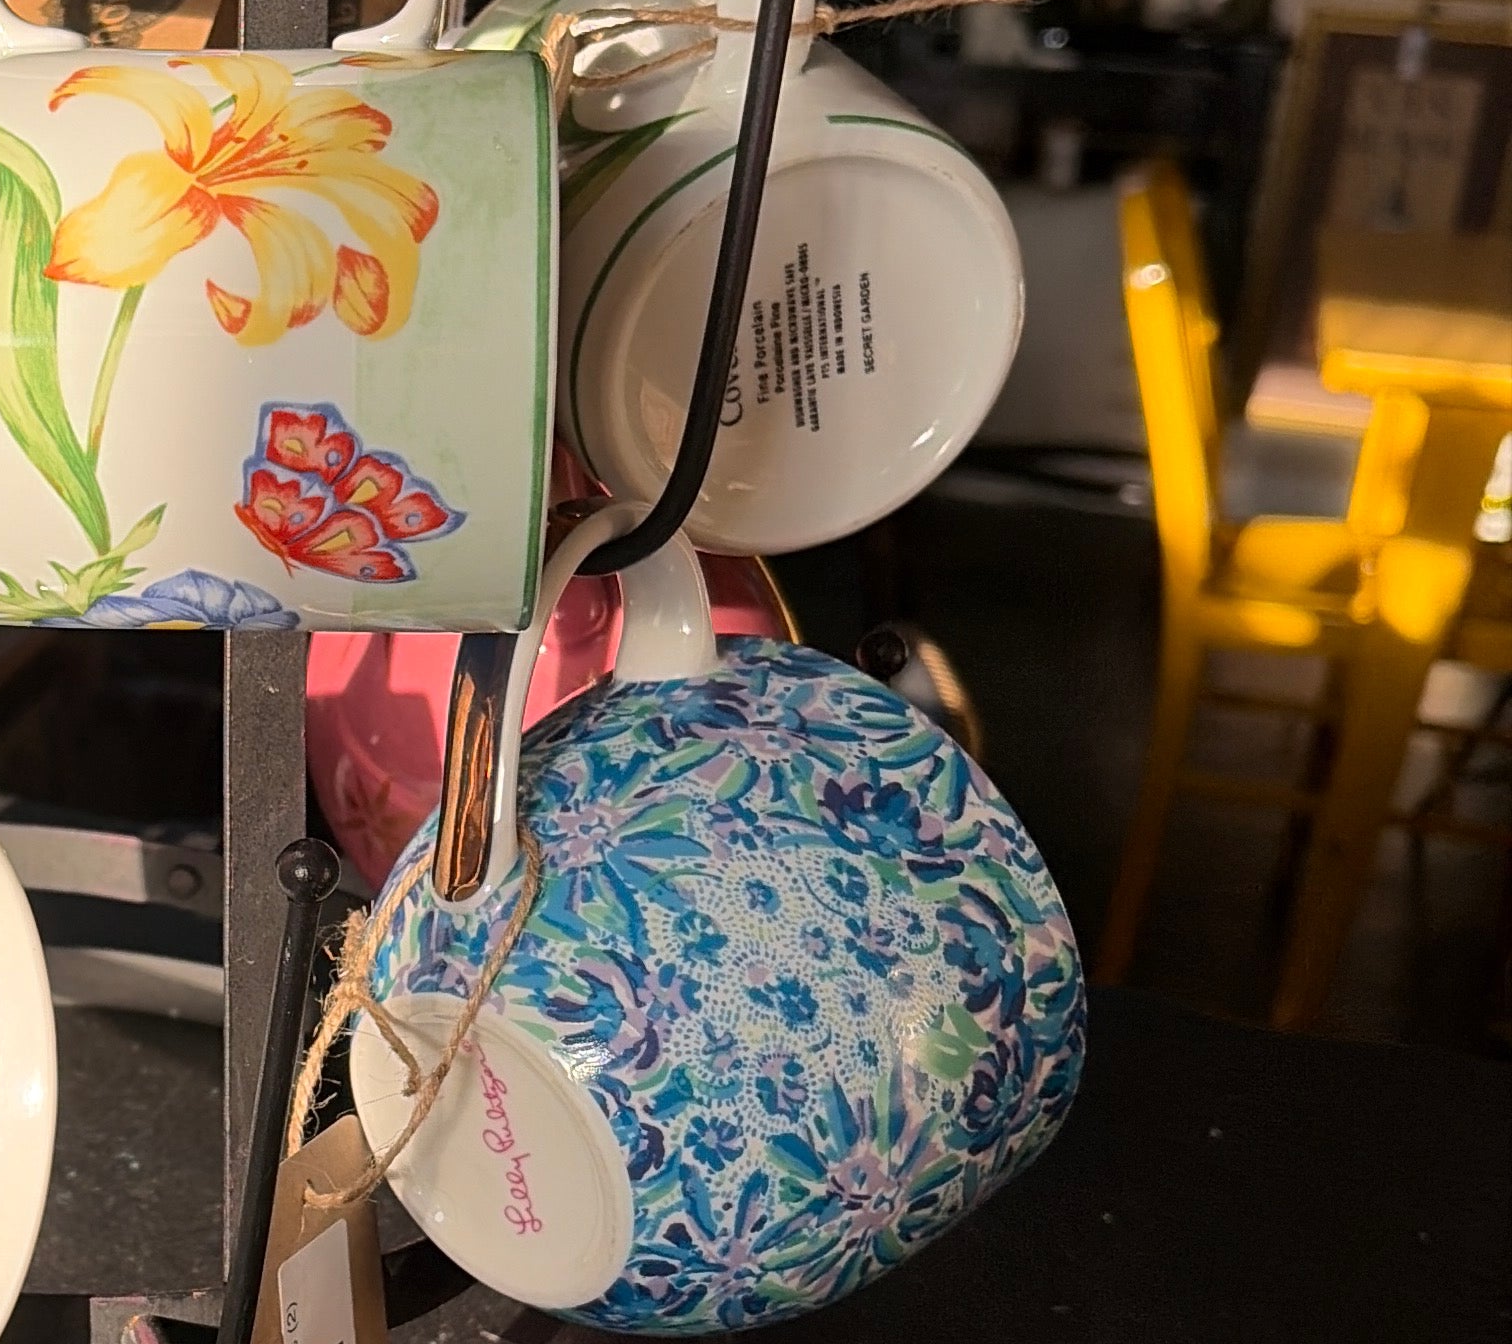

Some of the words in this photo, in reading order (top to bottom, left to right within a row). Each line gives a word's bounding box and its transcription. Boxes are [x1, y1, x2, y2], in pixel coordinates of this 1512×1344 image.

[785, 264, 794, 285] SAFE
[859, 273, 871, 323] GARDEN
[786, 288, 798, 344] MICROWAVE
[816, 289, 828, 360] INTERNATIONAL
[832, 284, 843, 333] INDONESIA
[752, 301, 767, 369] Porcelain
[834, 336, 843, 346] IN
[862, 328, 875, 374] SECRET
[835, 350, 845, 374] MADE
[757, 374, 769, 403] Fine
[503, 1153, 542, 1236] Lilly
[286, 1301, 299, 1334] (2)
